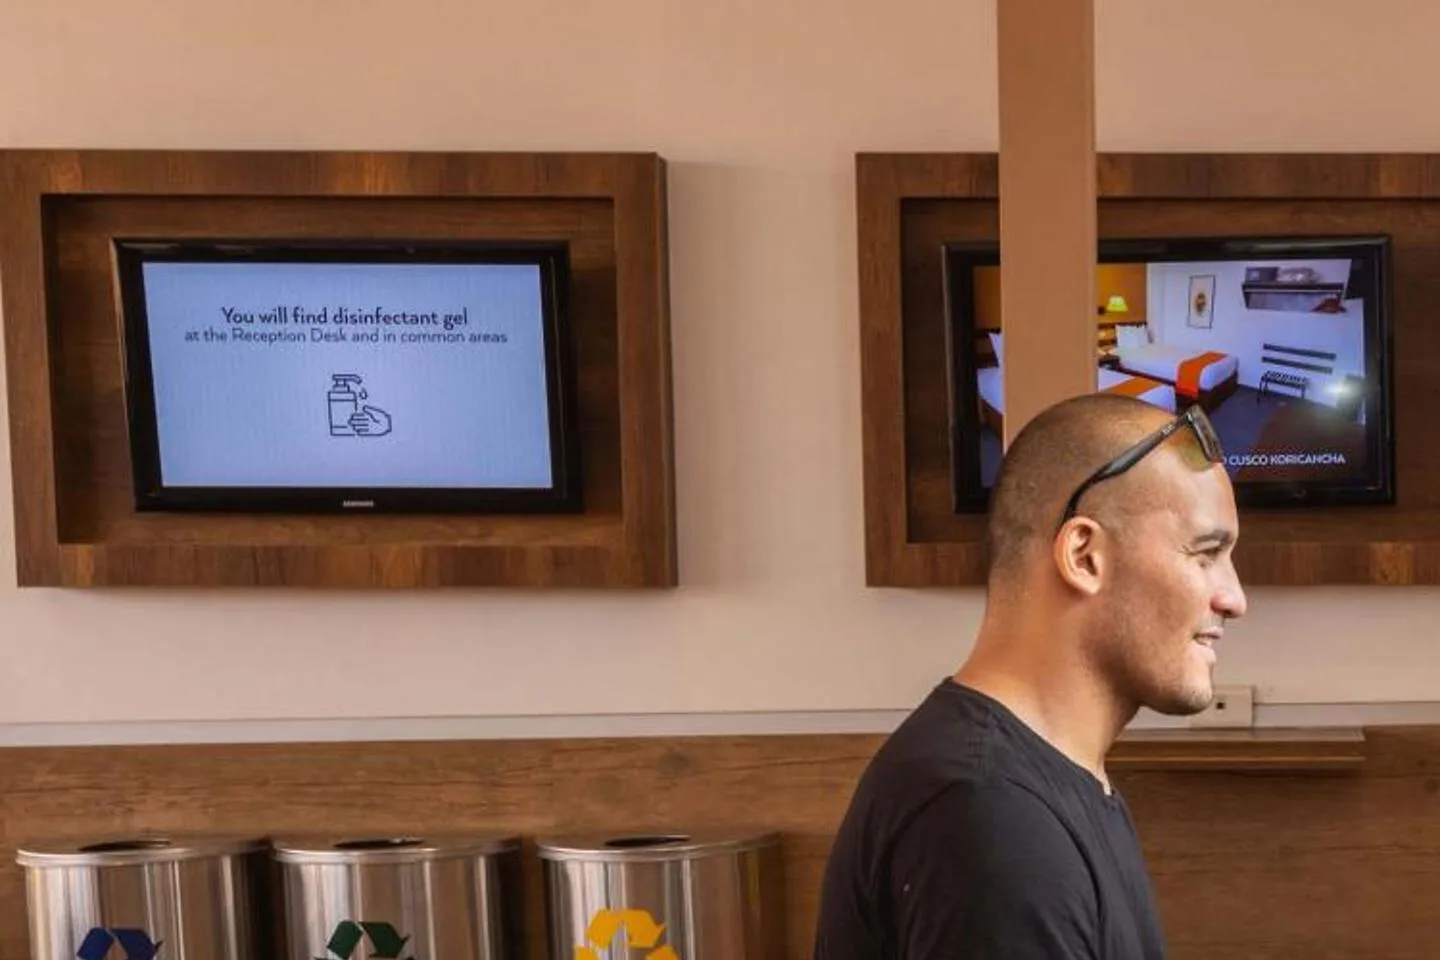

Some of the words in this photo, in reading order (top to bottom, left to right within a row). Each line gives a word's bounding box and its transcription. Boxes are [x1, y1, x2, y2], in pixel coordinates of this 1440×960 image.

[221, 306, 254, 324] You
[258, 306, 288, 324] will
[292, 306, 328, 324] find
[333, 306, 439, 325] disinfectant
[443, 306, 468, 330] gel
[184, 330, 200, 342] at
[203, 327, 228, 342] the
[232, 327, 306, 346] Reception
[310, 327, 348, 342] Desk
[351, 327, 379, 343] and
[383, 328, 396, 343] in
[400, 331, 465, 343] common
[468, 331, 508, 343] areas
[1228, 456, 1268, 466] CUSCO
[1270, 454, 1346, 466] KORICANCHA
